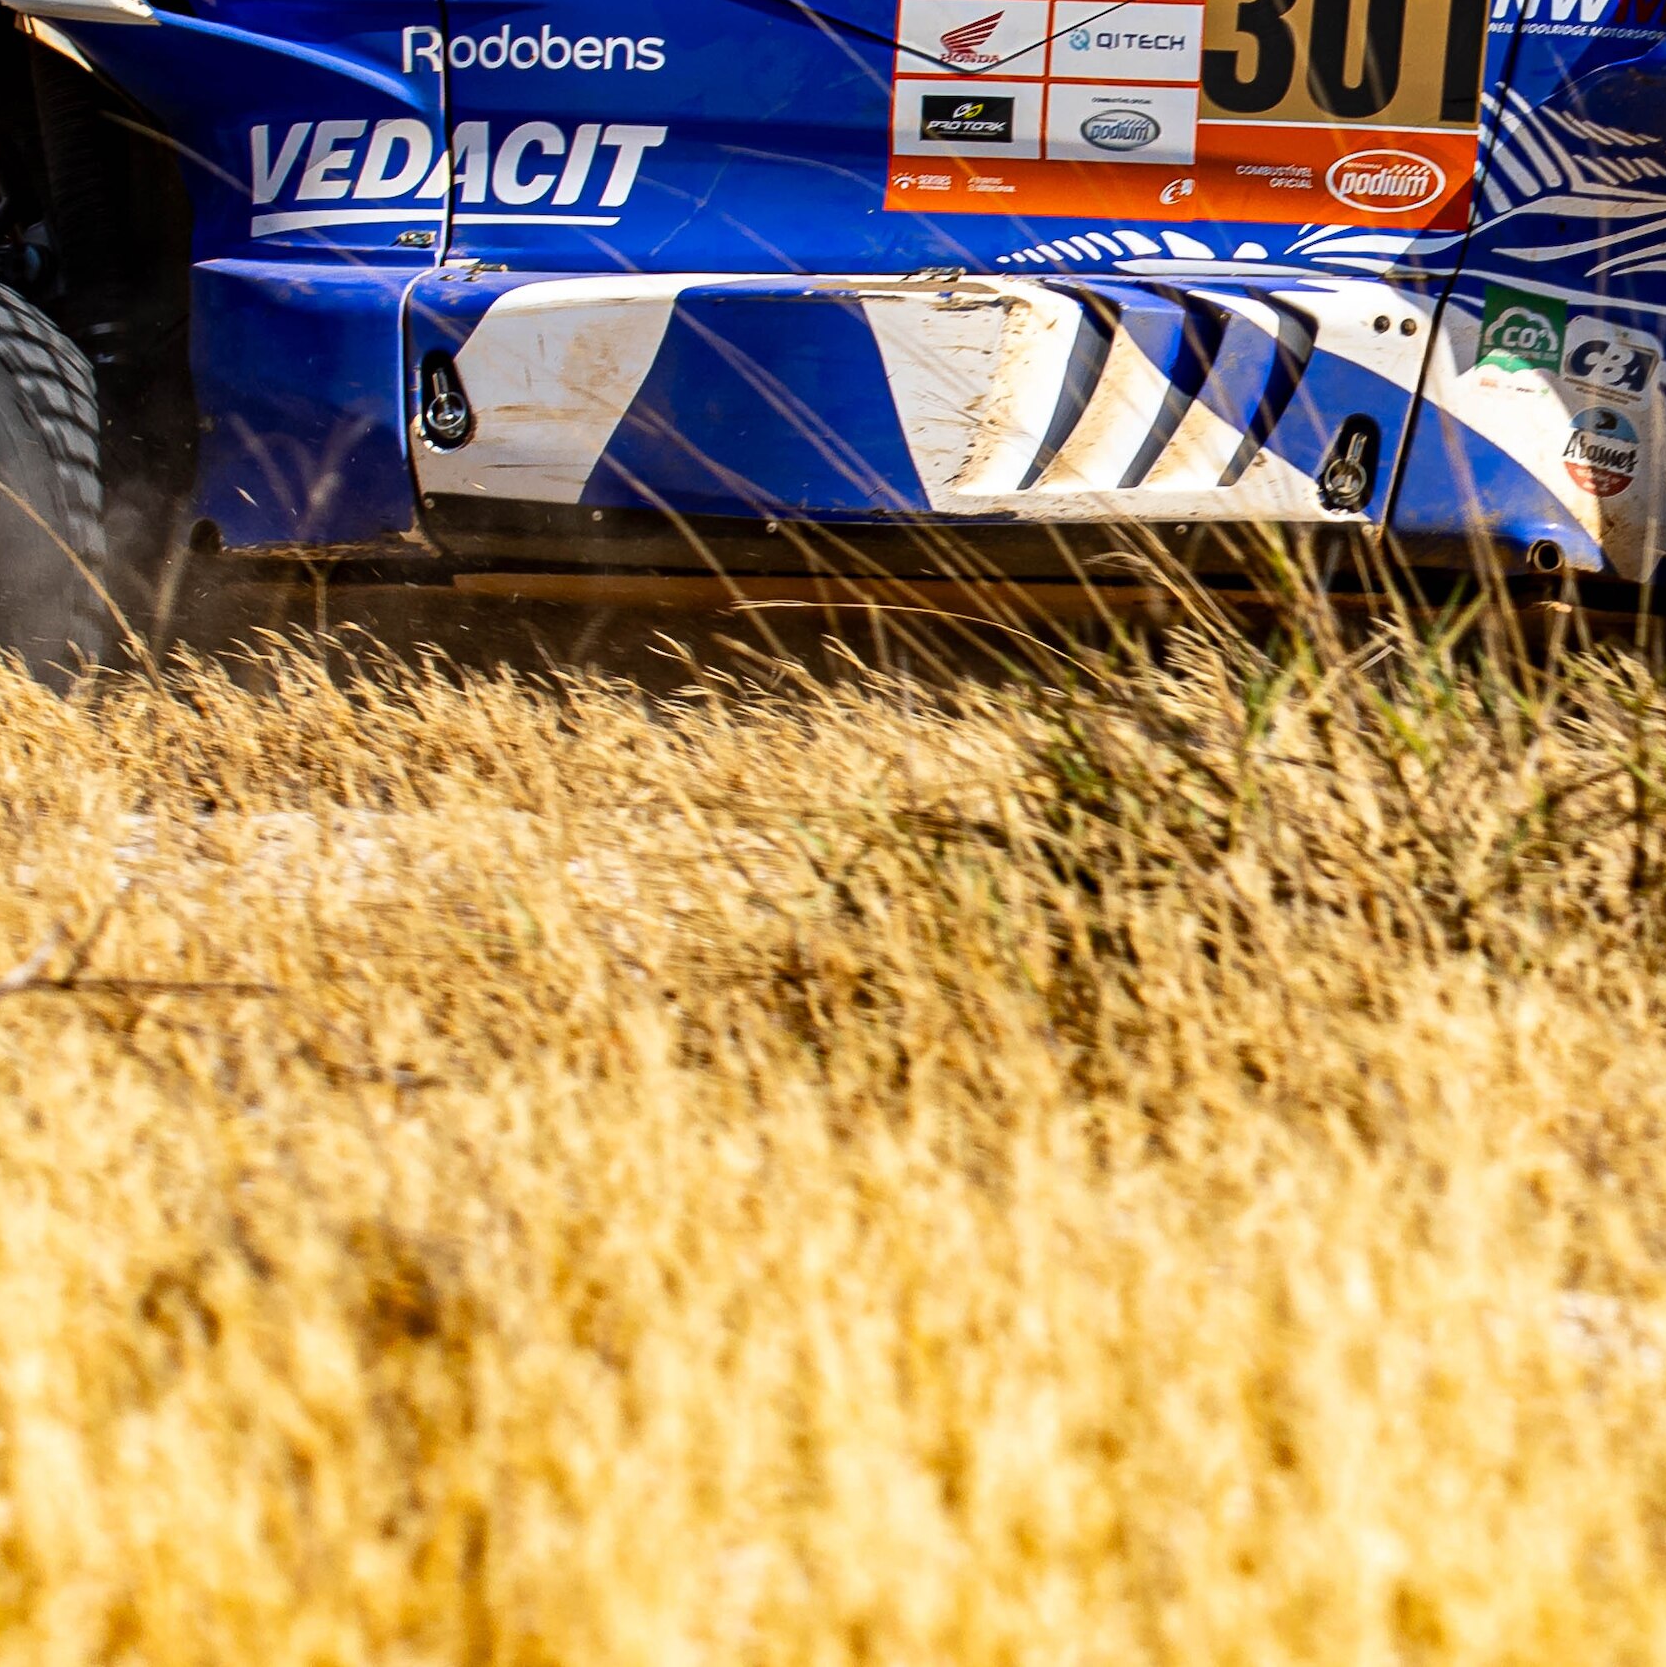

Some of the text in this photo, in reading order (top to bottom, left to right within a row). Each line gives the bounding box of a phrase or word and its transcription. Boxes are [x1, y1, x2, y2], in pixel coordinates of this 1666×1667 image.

[401, 24, 666, 73] Rodobens
[940, 52, 1002, 65] HONDA
[249, 118, 669, 208] VEDACIT
[1340, 168, 1431, 199] podium
[1569, 338, 1650, 392] CBA
